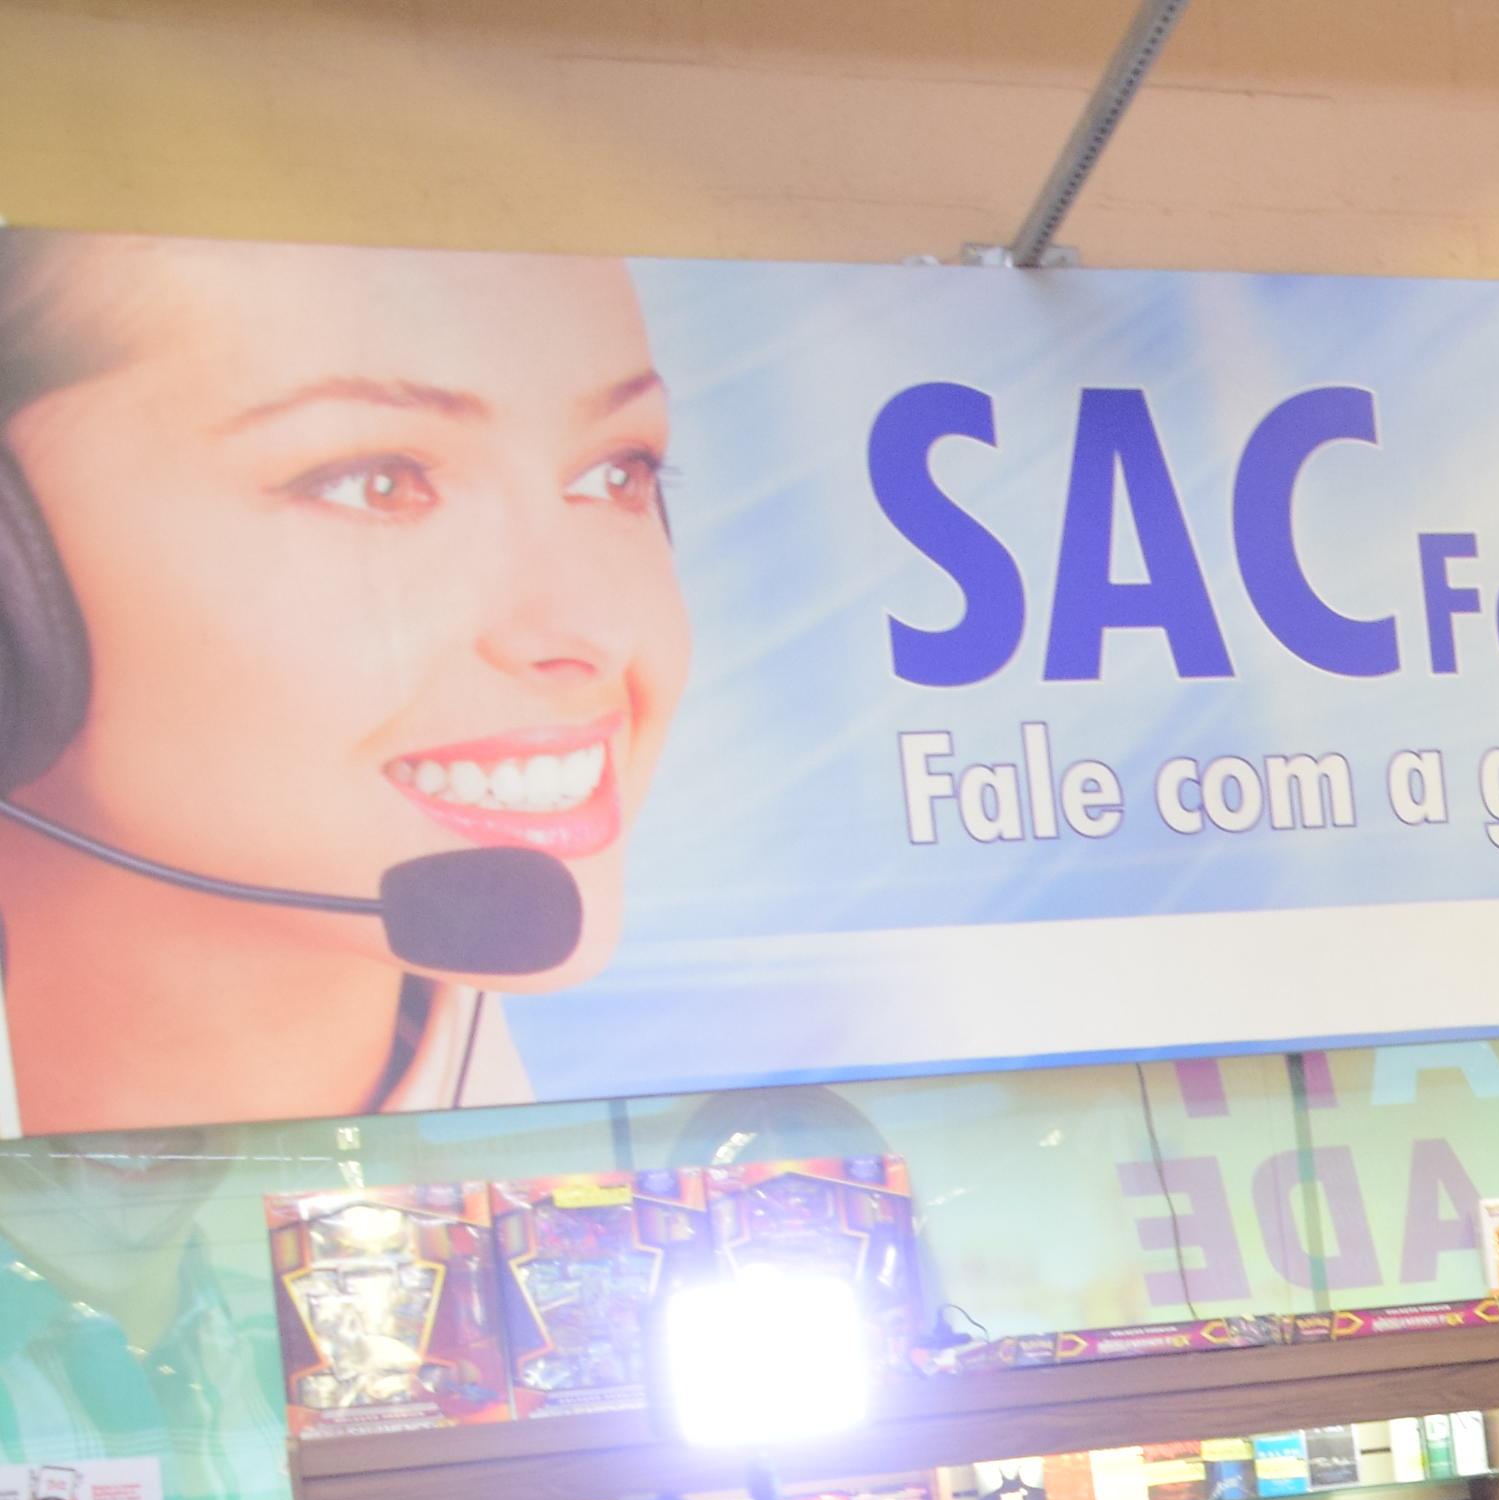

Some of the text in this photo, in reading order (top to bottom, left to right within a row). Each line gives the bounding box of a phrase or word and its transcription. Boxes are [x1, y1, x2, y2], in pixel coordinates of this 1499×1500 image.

[866, 380, 1401, 689] SAC
[897, 721, 1124, 846] Fale
[1156, 746, 1358, 836] com
[1387, 749, 1448, 825] a
